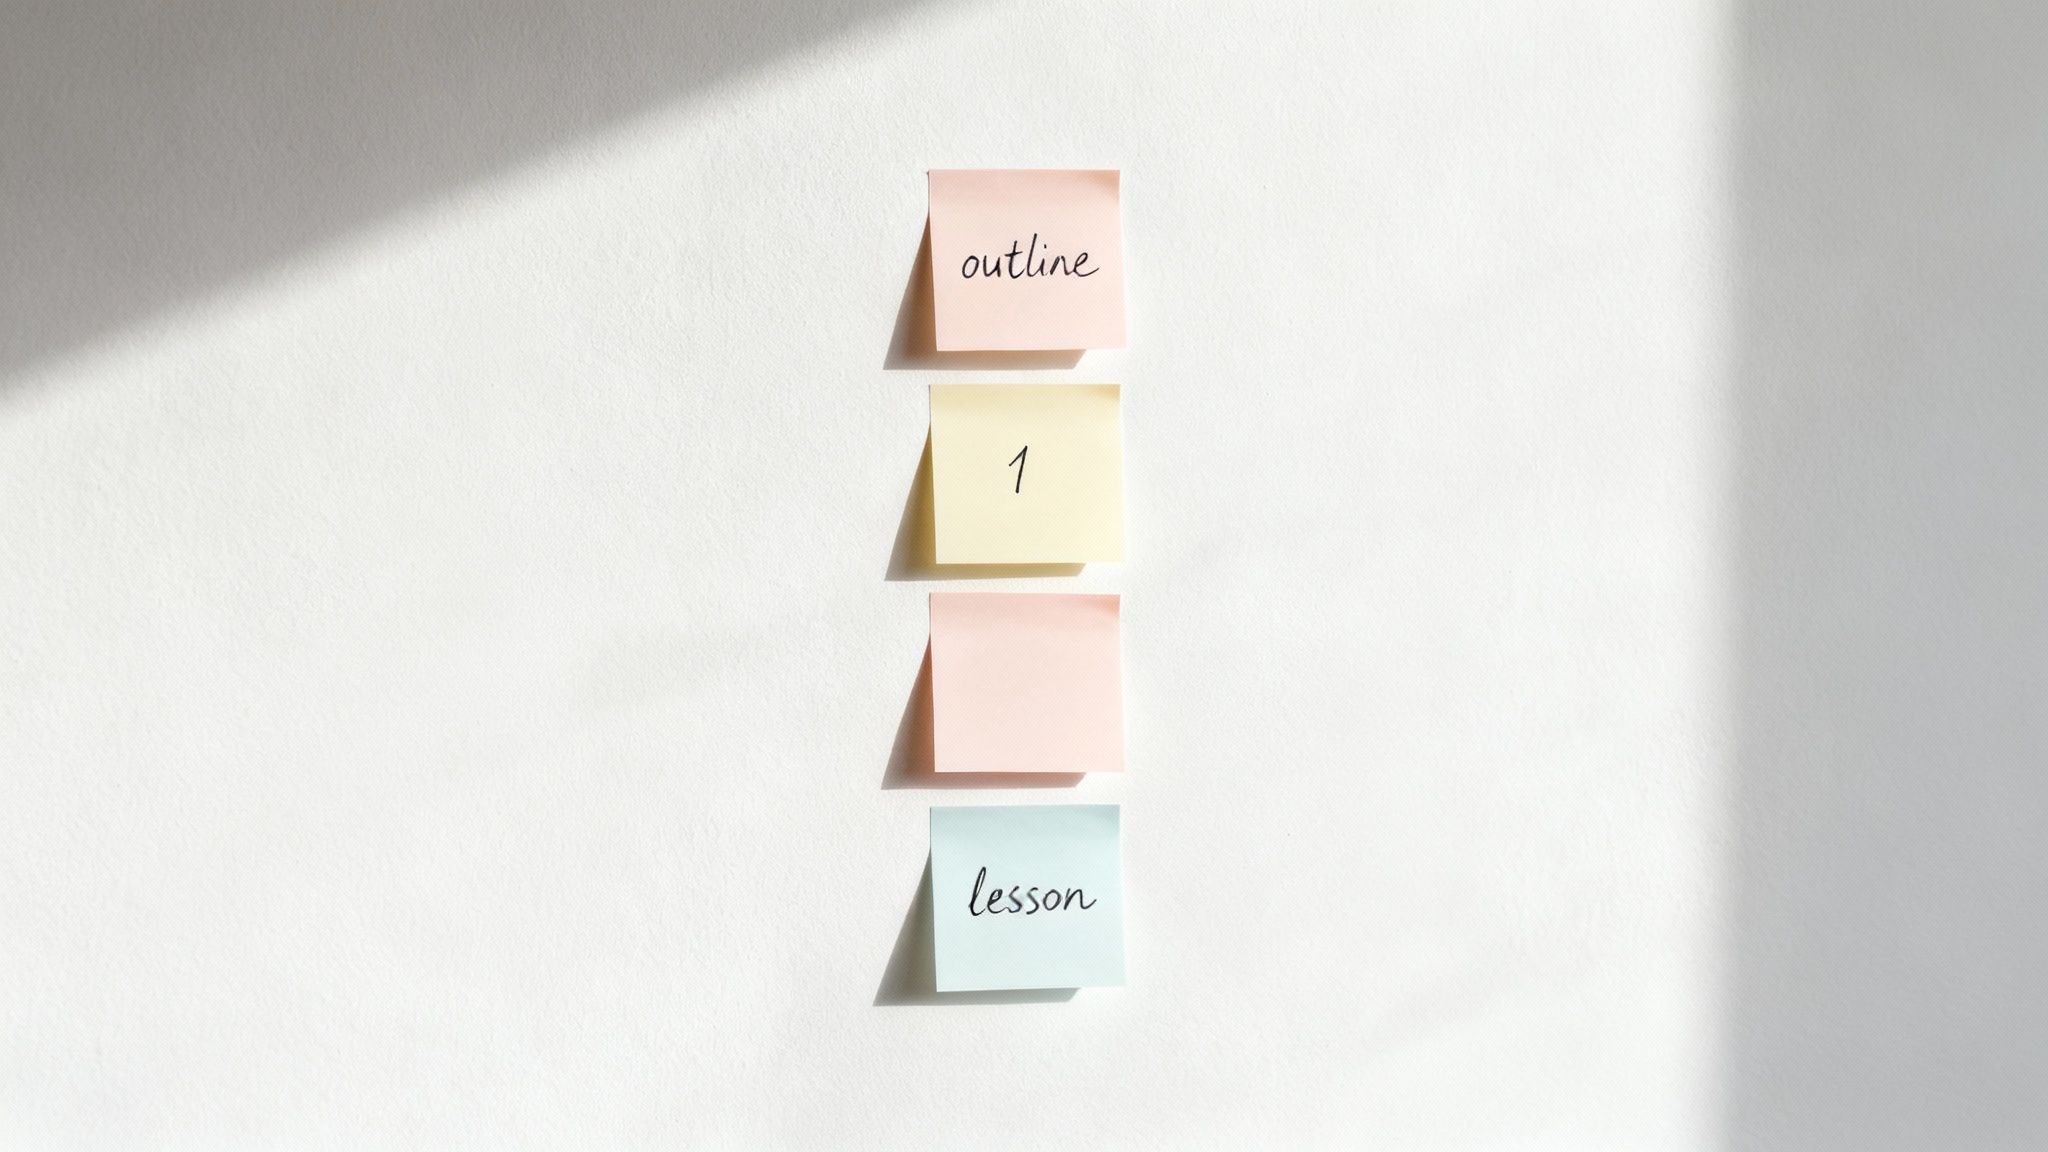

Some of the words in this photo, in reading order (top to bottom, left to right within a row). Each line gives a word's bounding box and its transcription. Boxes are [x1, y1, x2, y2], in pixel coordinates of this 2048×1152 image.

[961, 232, 1100, 280] outline
[1008, 445, 1028, 494] 1
[968, 866, 1097, 917] lesson
